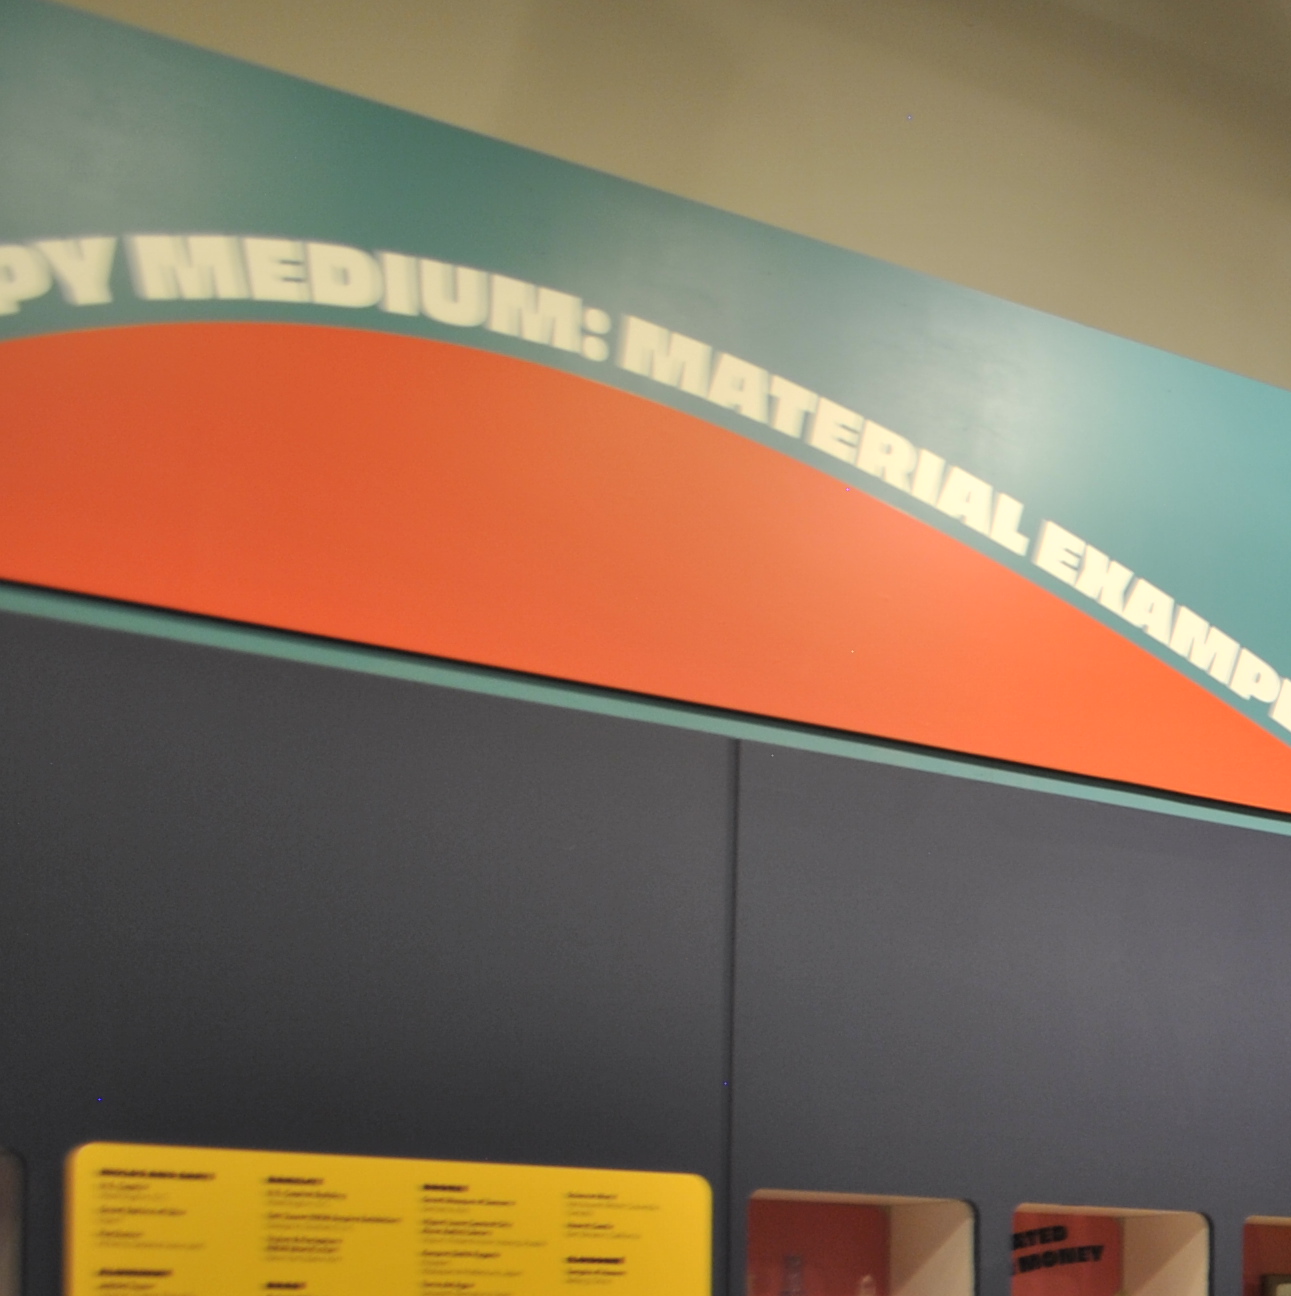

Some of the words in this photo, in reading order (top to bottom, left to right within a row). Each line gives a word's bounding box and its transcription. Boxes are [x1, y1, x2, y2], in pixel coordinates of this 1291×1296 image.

[123, 233, 613, 362] MEDIUM:
[617, 313, 1030, 557] MATERIAL
[1018, 1244, 1104, 1274] MONEY
